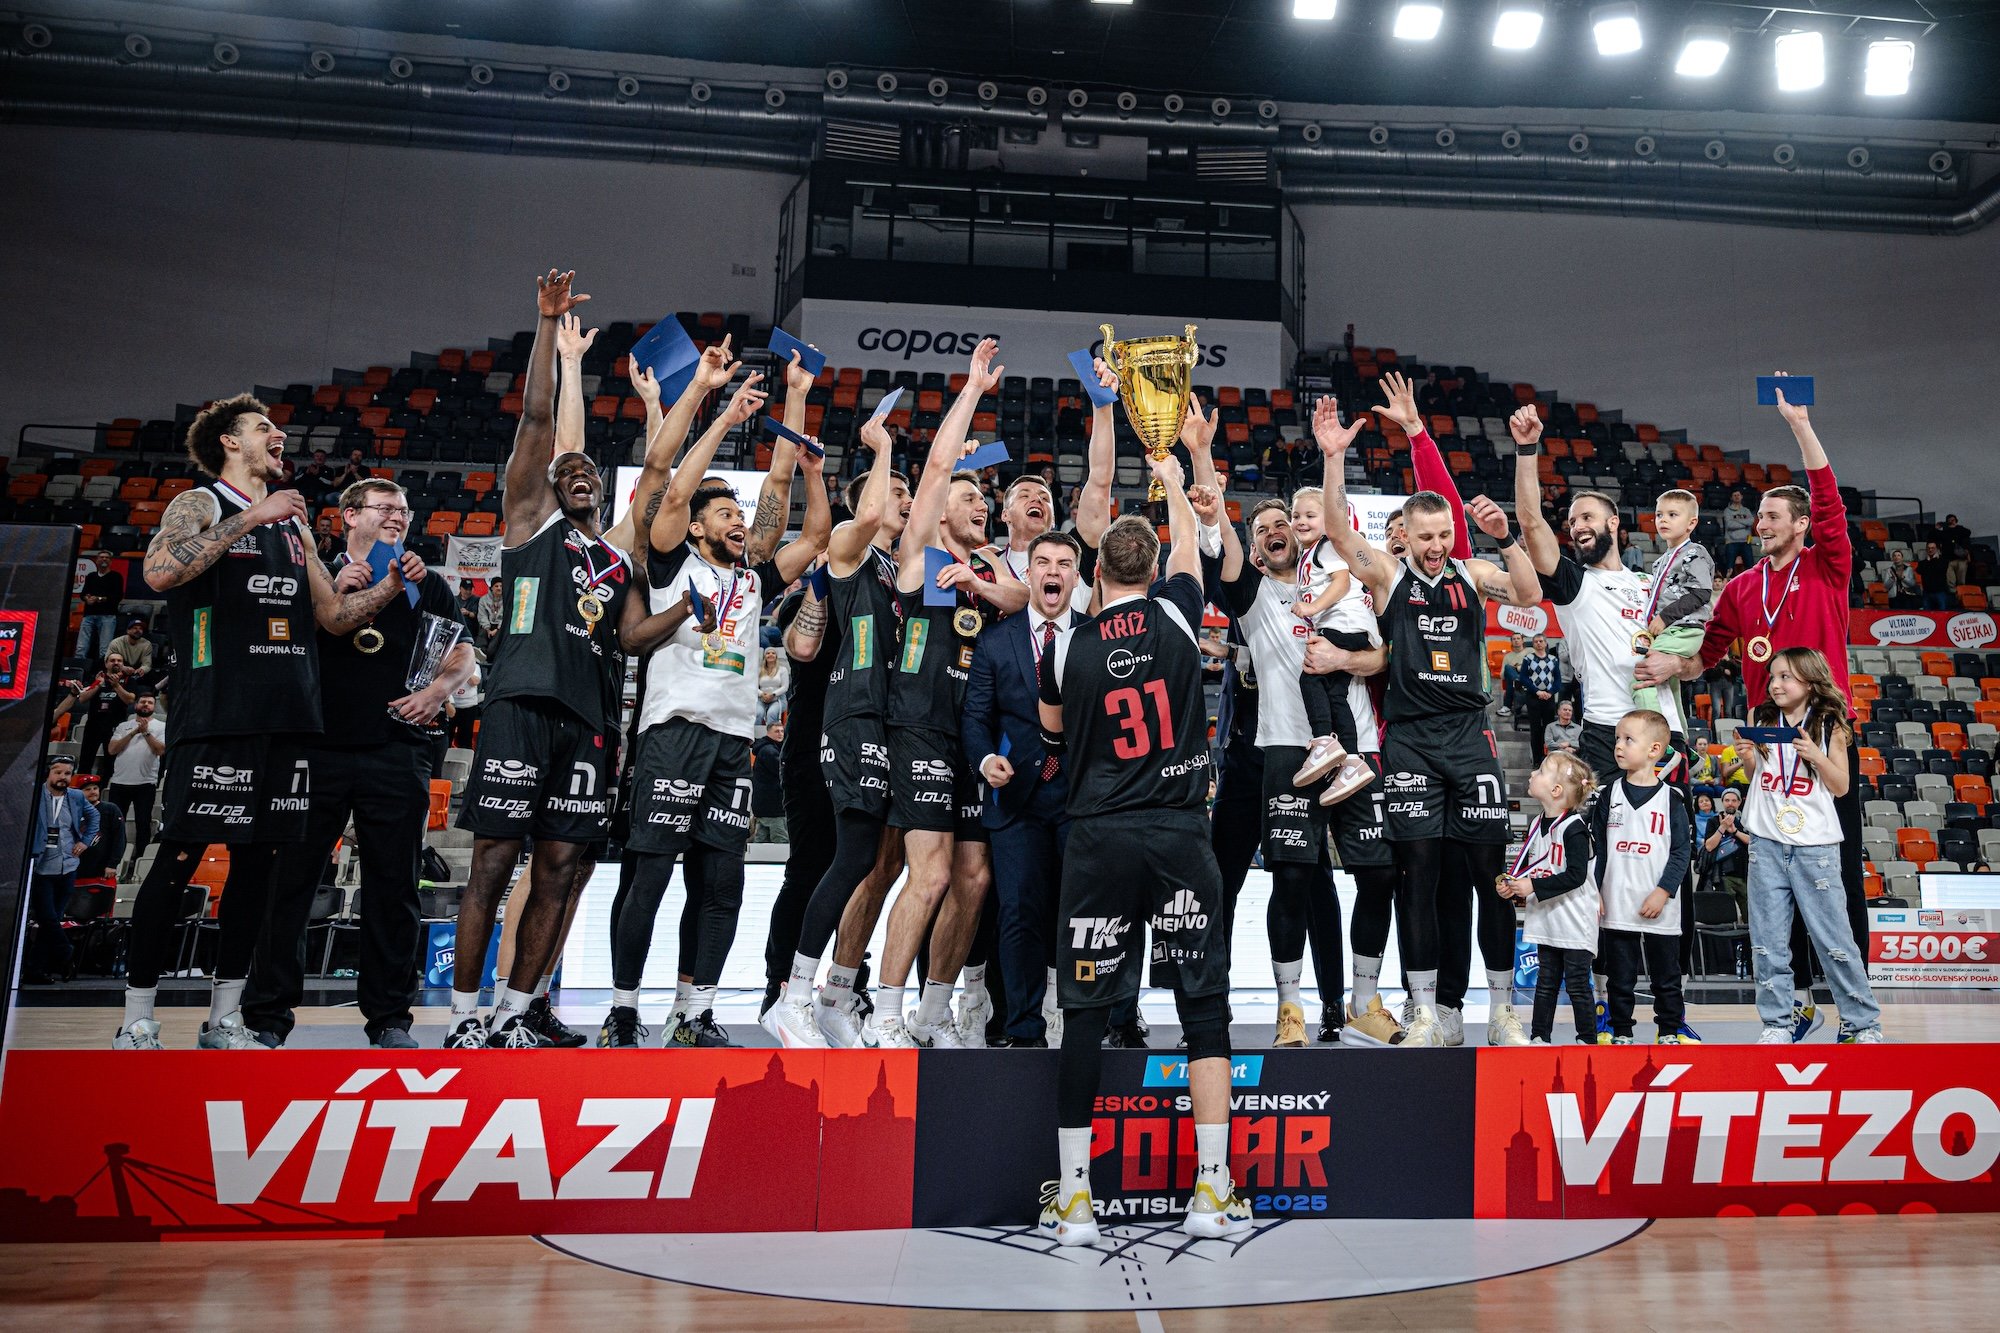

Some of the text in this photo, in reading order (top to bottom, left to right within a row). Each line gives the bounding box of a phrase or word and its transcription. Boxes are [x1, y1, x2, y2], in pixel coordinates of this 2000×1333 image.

[247, 574, 298, 596] era
[1444, 582, 1468, 611] 11
[1100, 611, 1148, 641] KŘÍŽ
[1418, 614, 1458, 633] era
[1506, 611, 1538, 631] BRNO!
[1889, 618, 1917, 629] VLTAVA?
[1952, 623, 1994, 642] ŠVEJKA!
[249, 645, 306, 655] SKUPINA ČEZ
[1110, 653, 1154, 669] OMNIPOL
[1418, 672, 1468, 683] SKUPINA ČEZ
[1104, 679, 1175, 760] 31
[192, 782, 254, 792] CONSTRUCTION
[1650, 812, 1665, 835] 11
[1551, 843, 1563, 866] 11
[1616, 841, 1651, 854] era
[1880, 935, 1988, 960] 3500€
[205, 1068, 717, 1204] VÍŤAZI
[1255, 1195, 1327, 1211] 2025
